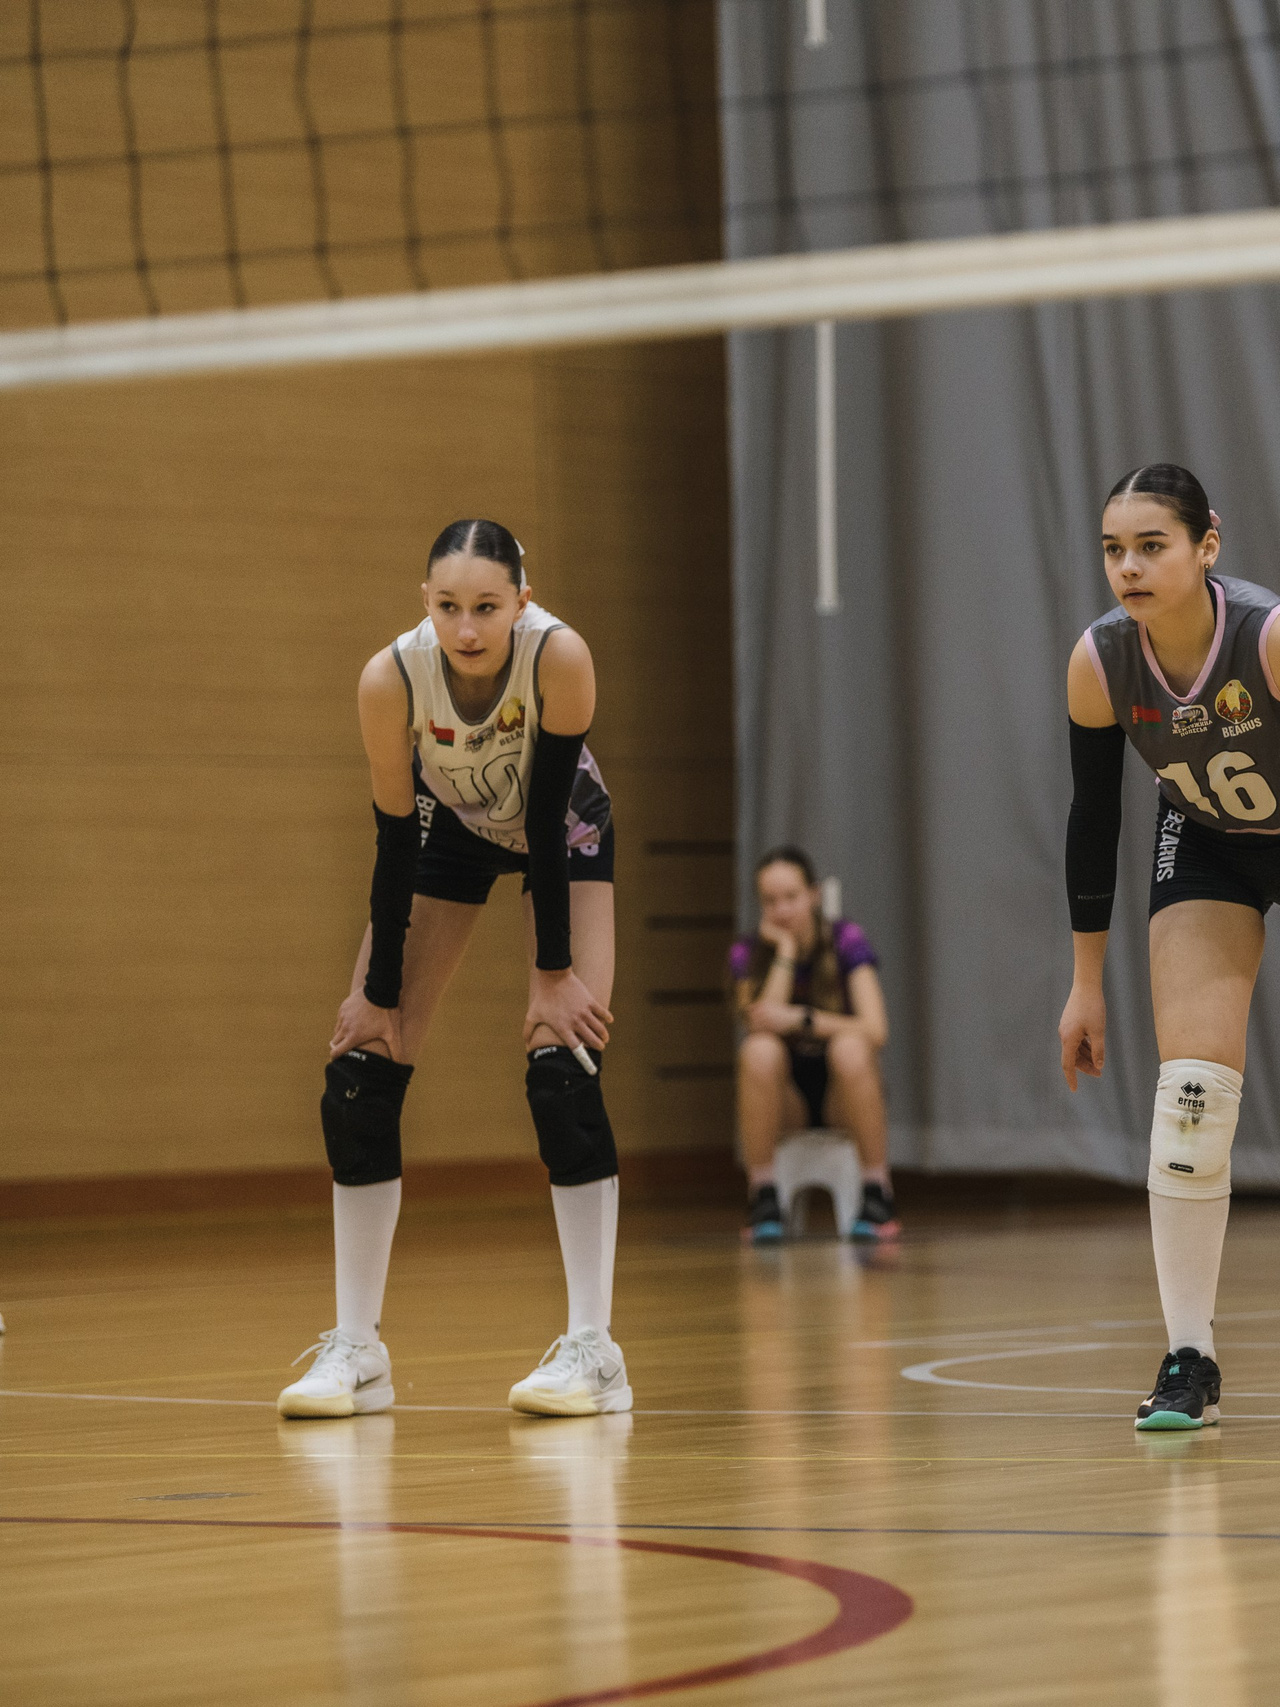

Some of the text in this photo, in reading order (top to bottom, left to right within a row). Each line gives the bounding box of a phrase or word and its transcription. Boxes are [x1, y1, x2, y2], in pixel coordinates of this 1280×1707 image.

[438, 750, 524, 823] 10
[1156, 750, 1277, 822] 16
[1156, 809, 1186, 882] BELARUS
